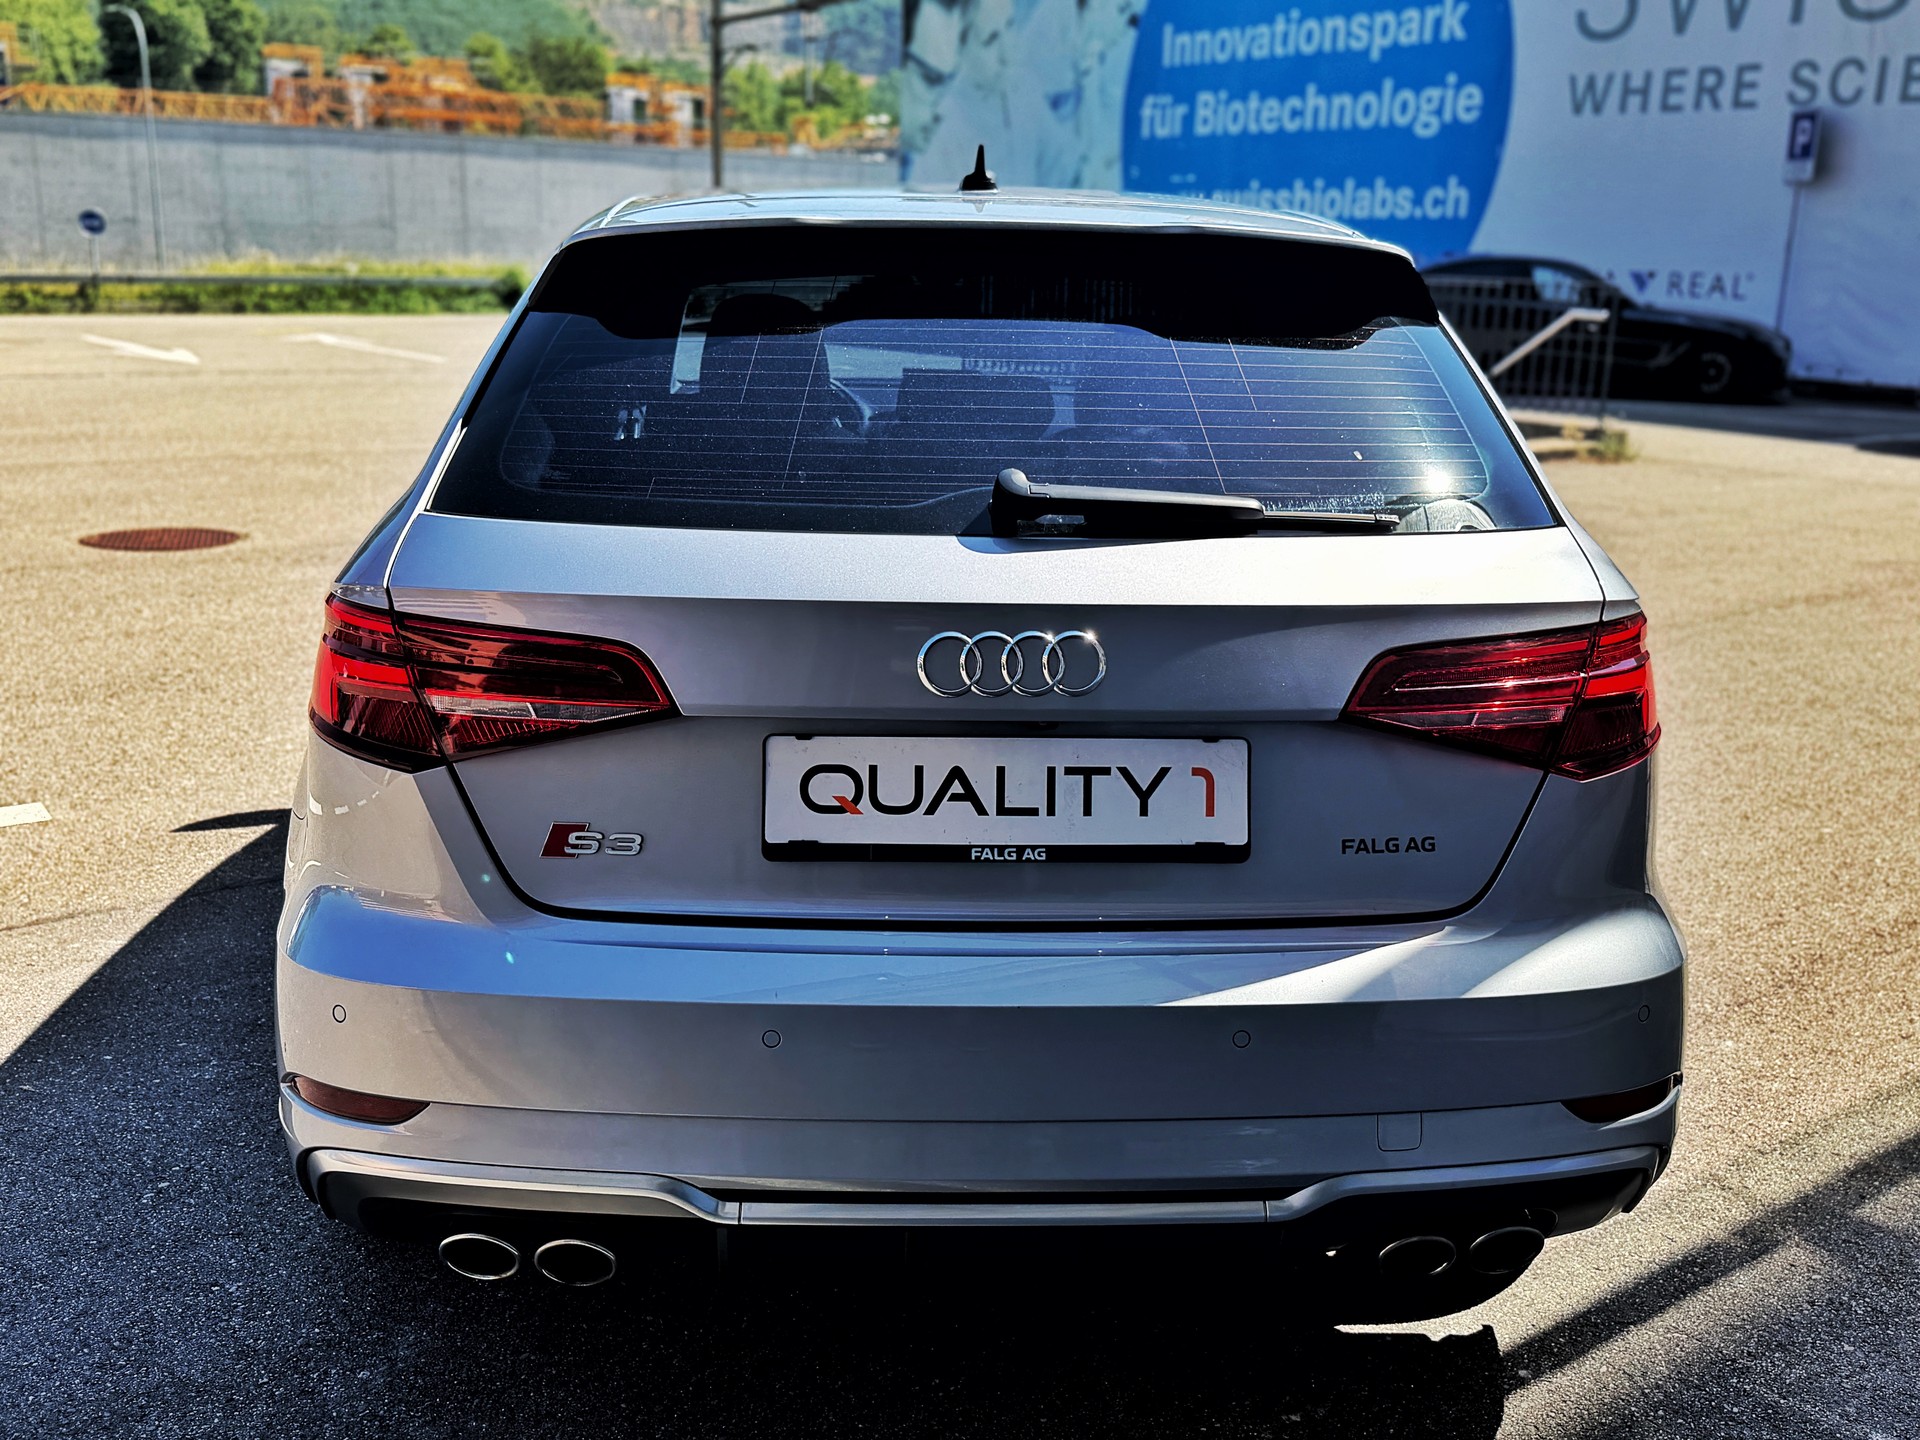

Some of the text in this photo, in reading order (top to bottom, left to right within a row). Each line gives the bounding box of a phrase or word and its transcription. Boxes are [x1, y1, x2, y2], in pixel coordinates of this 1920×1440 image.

[1161, 1, 1468, 69] Innovationspark
[1140, 73, 1484, 139] für Biotechnologie
[1569, 63, 1763, 117] WHERE
[799, 763, 1172, 817] QUALITY
[563, 830, 644, 856] S3
[971, 847, 1046, 860] FALG AG
[1341, 836, 1436, 855] FALG AG
